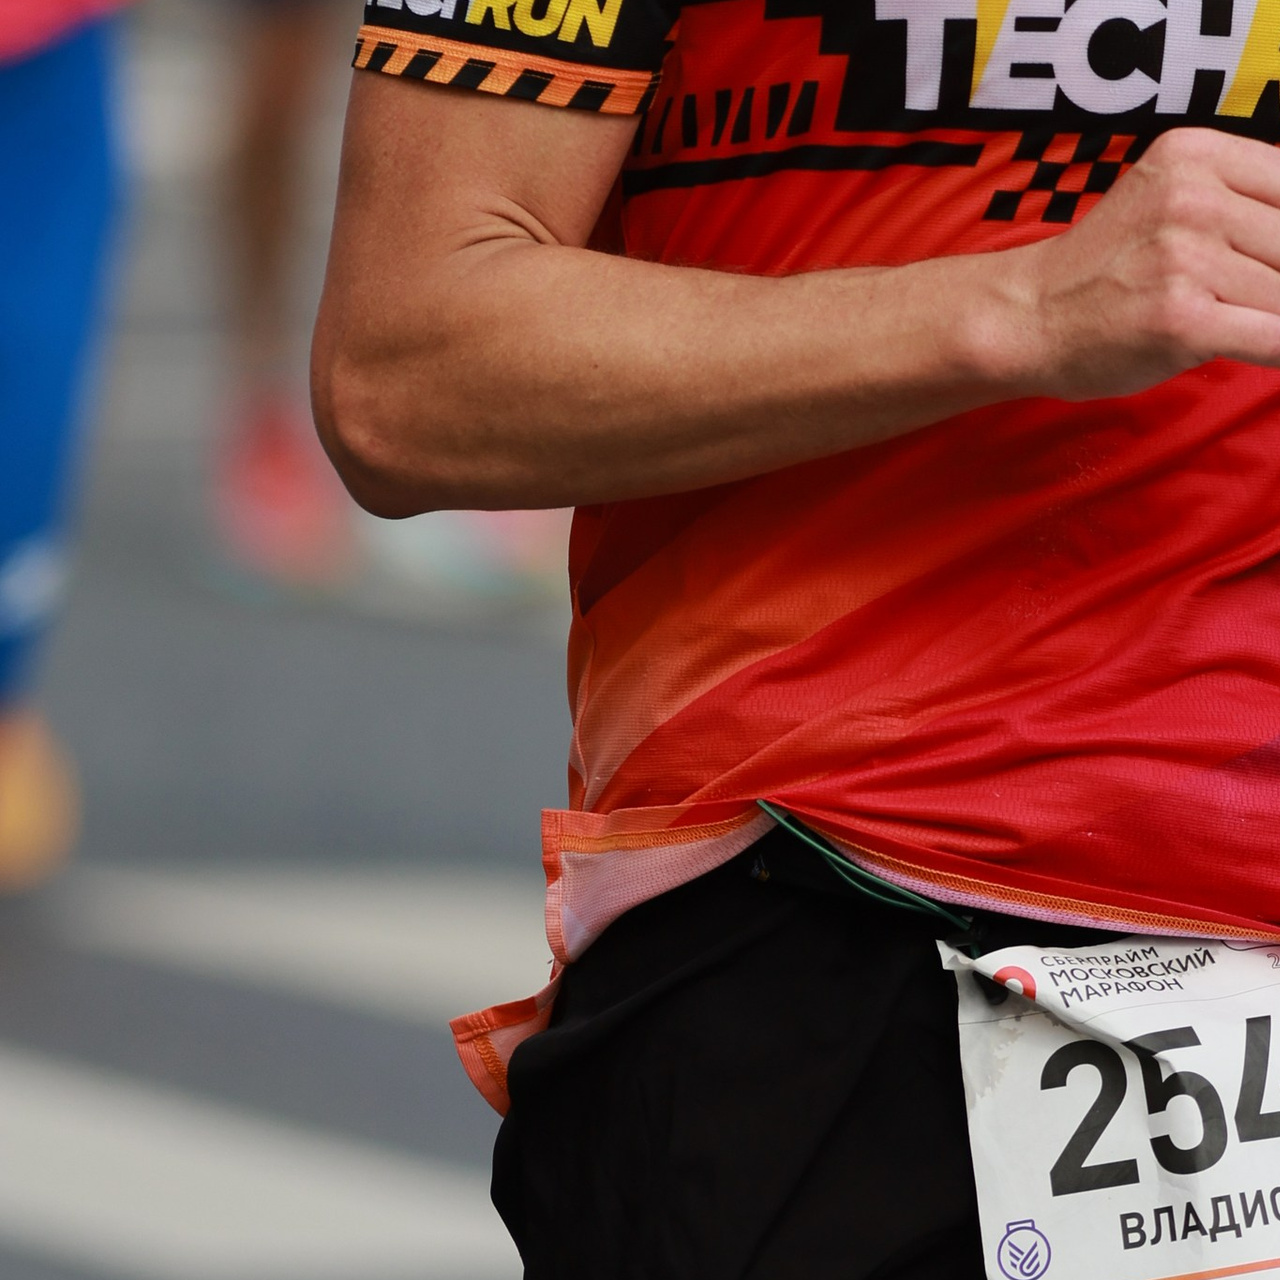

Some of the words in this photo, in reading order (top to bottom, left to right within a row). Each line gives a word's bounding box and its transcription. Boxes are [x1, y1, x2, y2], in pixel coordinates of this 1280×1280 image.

[1040, 946, 1160, 967] СБЕРПРАЙМ
[1049, 947, 1216, 986] МОСКОВСКИЙ
[1059, 978, 1184, 1008] МАРАФОН
